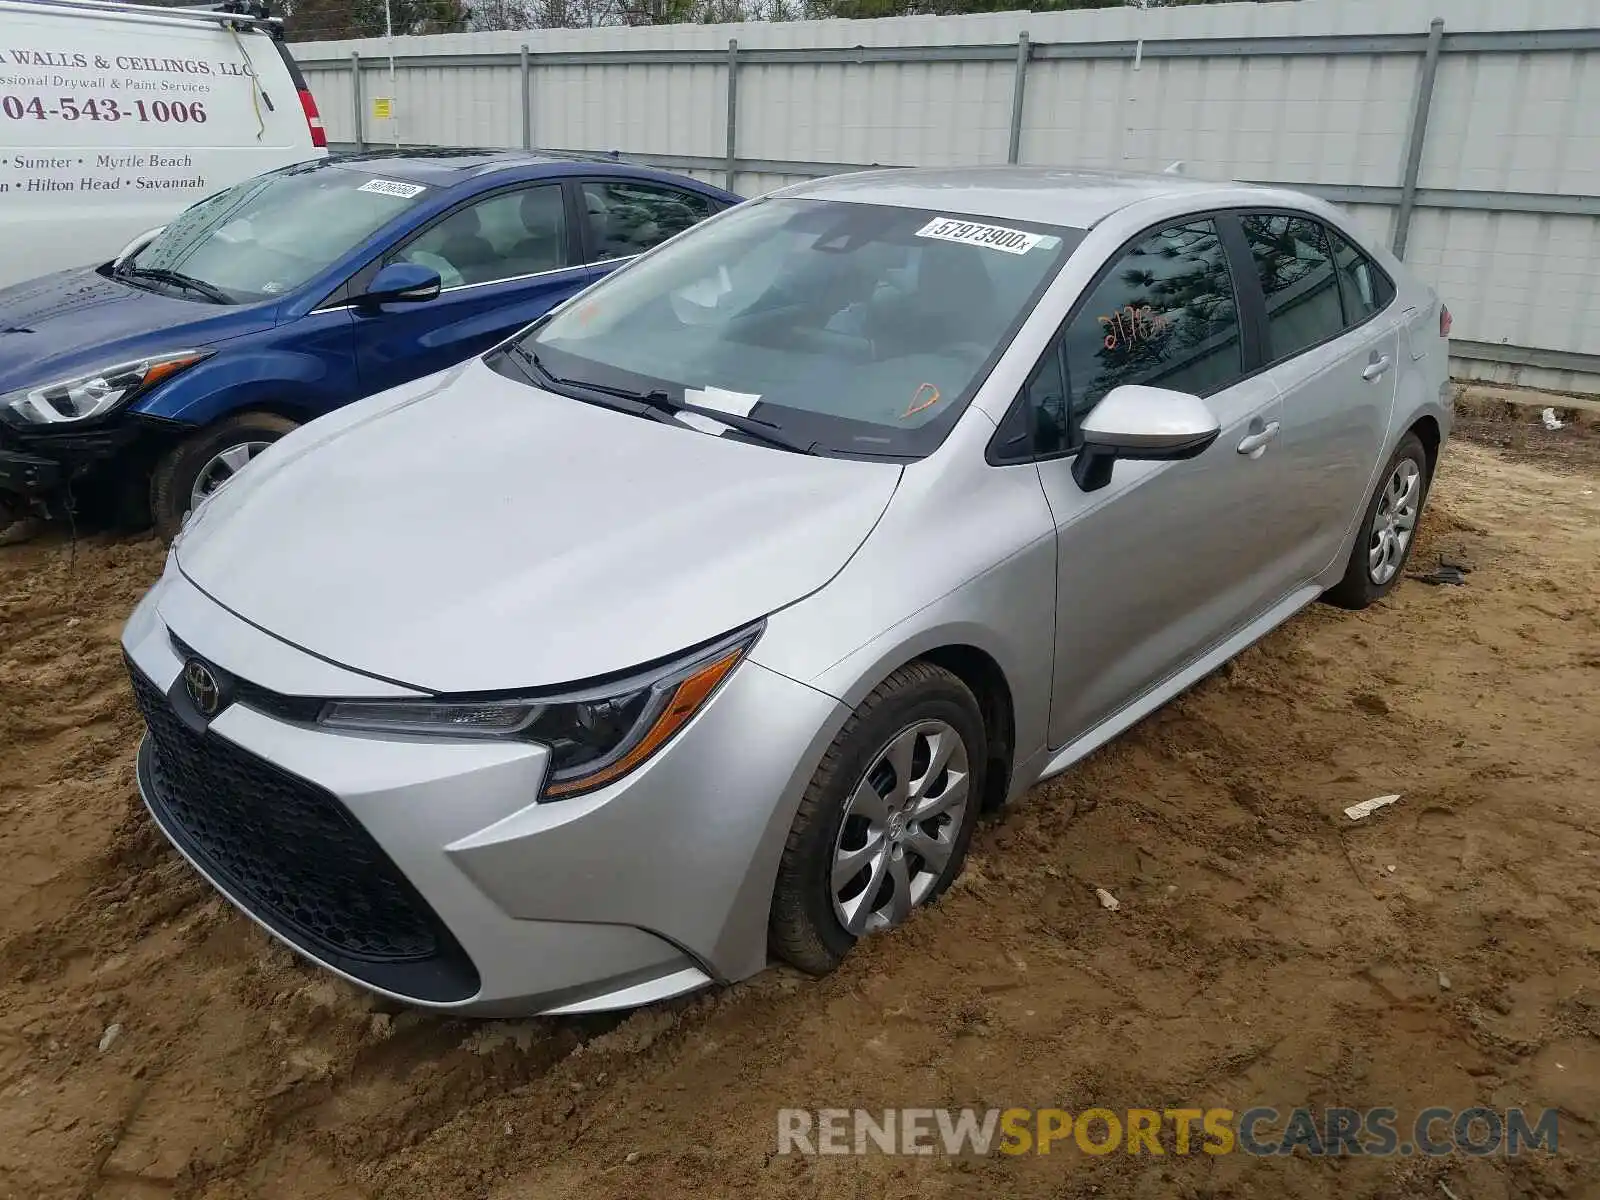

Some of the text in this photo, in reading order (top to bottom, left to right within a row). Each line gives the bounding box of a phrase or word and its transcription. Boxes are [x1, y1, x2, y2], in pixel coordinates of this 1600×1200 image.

[9, 50, 87, 69] WALLS
[95, 54, 110, 69] &
[116, 56, 215, 77] CEILINGS,
[53, 76, 105, 90] Drywall
[110, 79, 120, 89] &
[125, 79, 156, 91] Paint
[160, 81, 210, 93] Services
[3, 95, 207, 123] 04-543-1006
[14, 155, 192, 170] Sumter Myrtle Beach
[27, 178, 74, 192] Hilton
[80, 177, 120, 191] Head
[135, 176, 206, 190] Savannah
